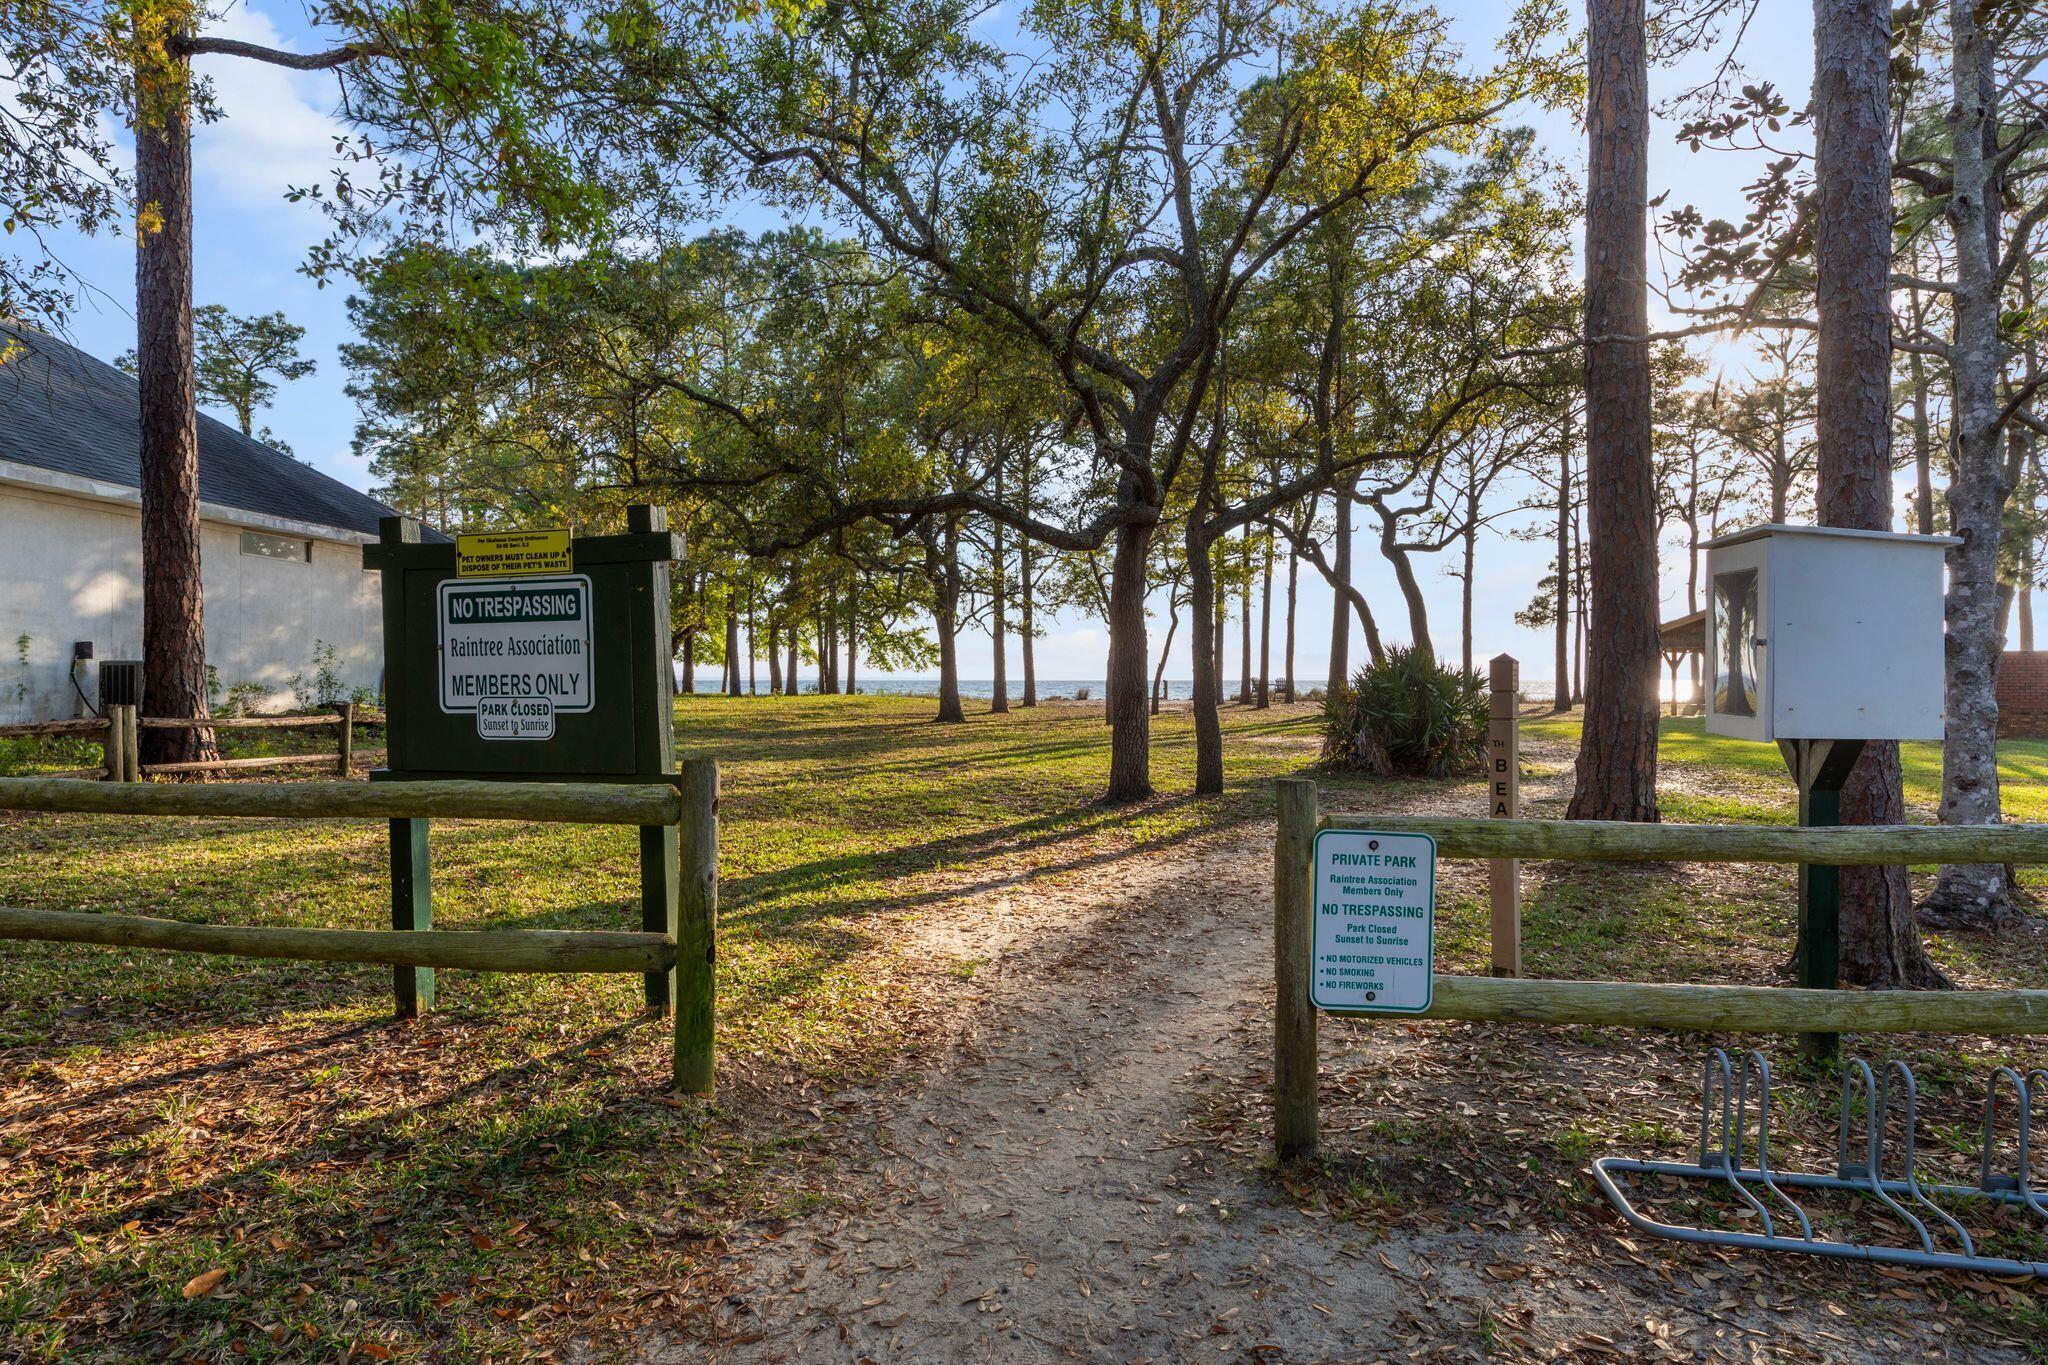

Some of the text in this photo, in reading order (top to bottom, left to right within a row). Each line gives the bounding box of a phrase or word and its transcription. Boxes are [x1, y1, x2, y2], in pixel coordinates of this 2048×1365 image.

[505, 553, 524, 561] MUST
[526, 552, 548, 560] CLEAN
[550, 551, 560, 559] UP
[562, 550, 566, 558] &
[462, 560, 568, 572] DISPOSE OF THEIR PET'S WASTE
[453, 594, 577, 619] NO TRESPASSING
[450, 634, 582, 658] Raintree Association
[452, 673, 580, 696] MEMBERS ONLY
[482, 703, 549, 716] PARK CLOSED
[483, 718, 549, 732] Sunset to Sunrise
[1332, 854, 1416, 868] PRIVATE PARK
[1330, 874, 1417, 886] Raintree Association
[1342, 886, 1404, 898] Members Only
[1322, 904, 1424, 918] NO TRESPASSING
[1348, 924, 1396, 934] Park Closed
[1336, 934, 1408, 946] Sunset to Sunrise
[1326, 955, 1424, 966] NO MOTORIZED VEHICLES
[1326, 968, 1374, 977] NO SMOKING
[1326, 981, 1384, 990] NO FIREWORKS
